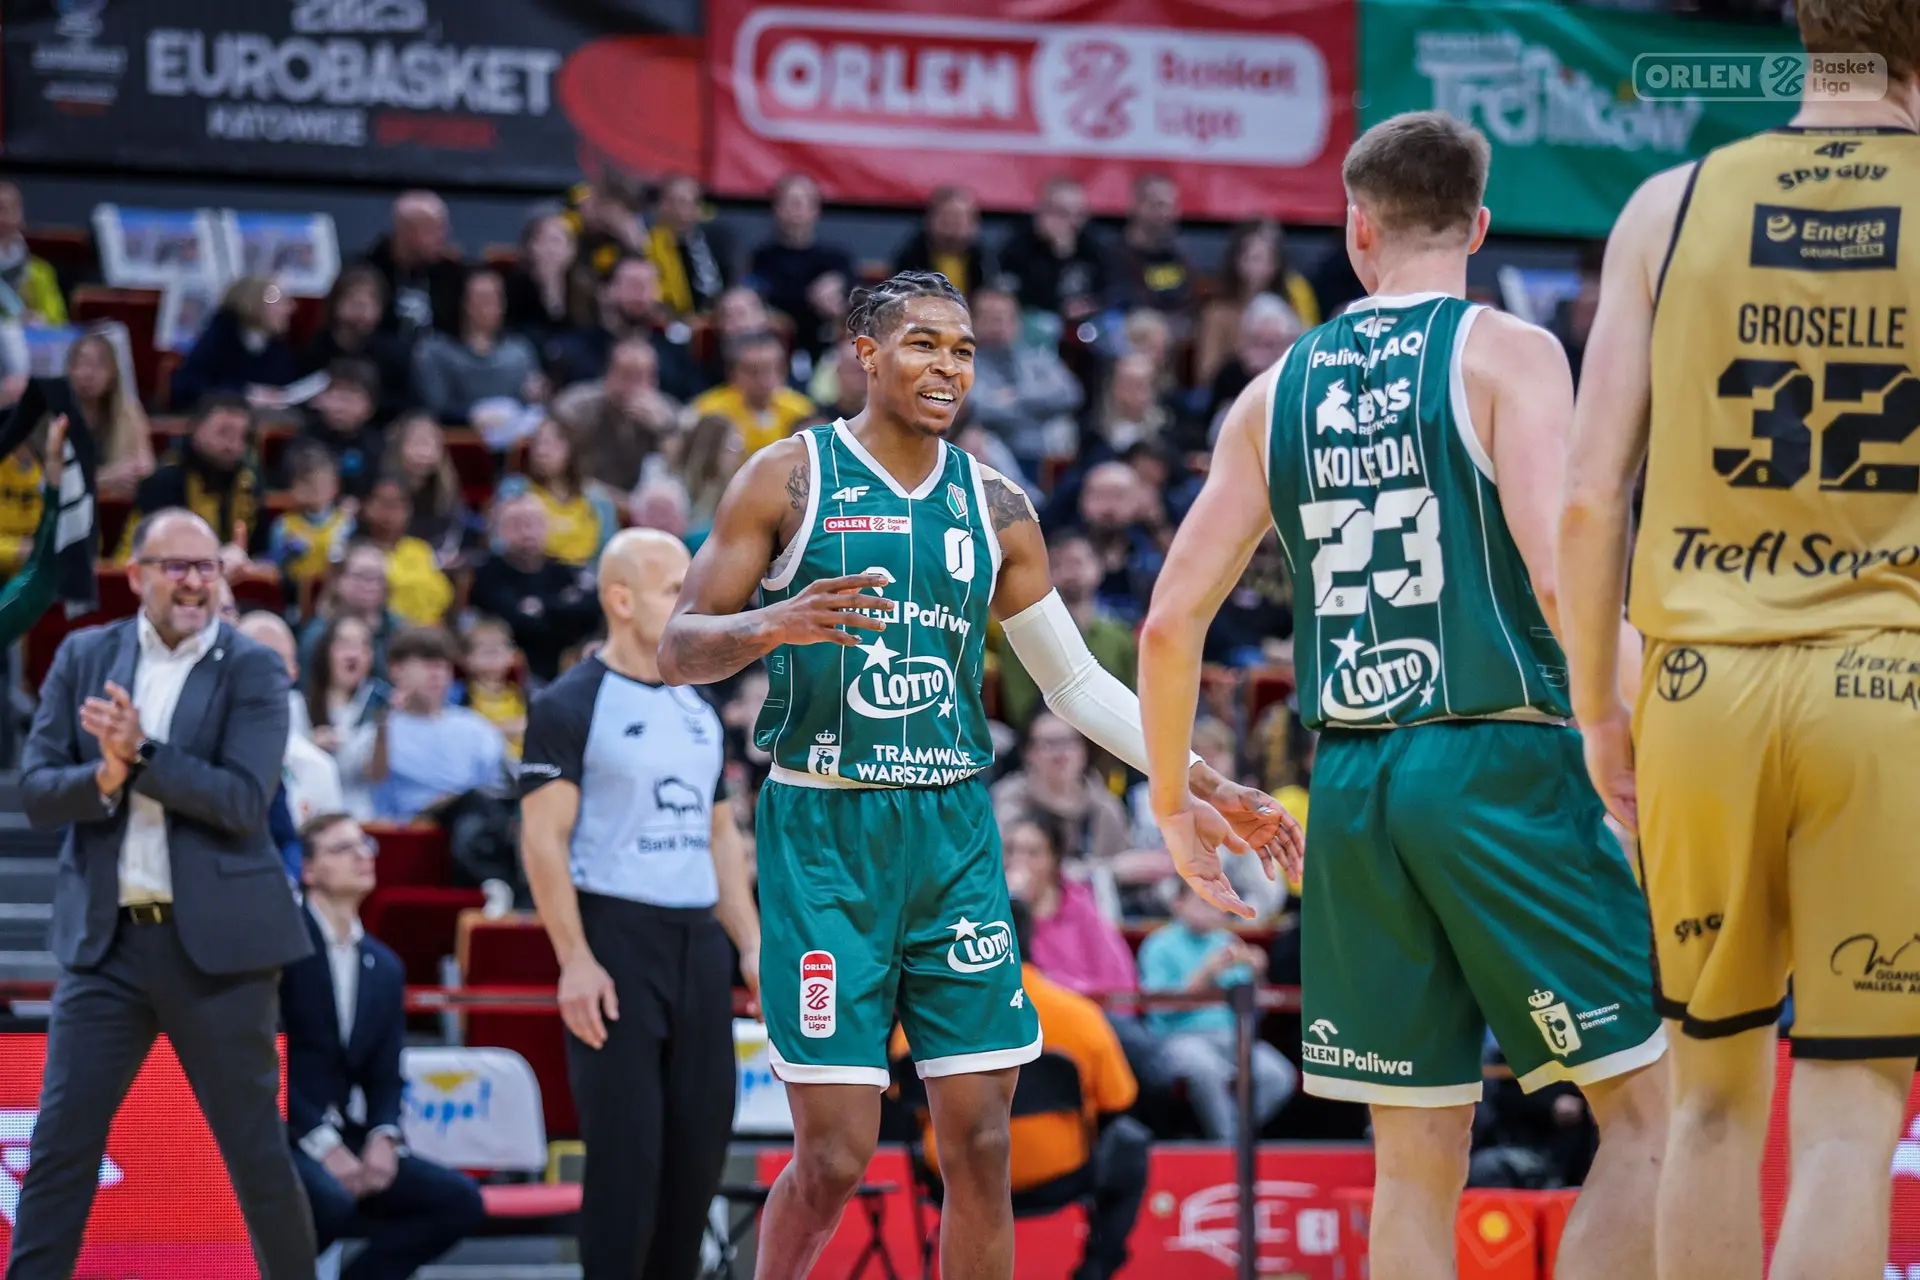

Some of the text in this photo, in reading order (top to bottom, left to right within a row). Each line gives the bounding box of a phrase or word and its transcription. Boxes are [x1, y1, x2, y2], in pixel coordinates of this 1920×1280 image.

[146, 29, 561, 116] EUROBASKET
[769, 38, 1018, 119] ORLEN
[1153, 48, 1297, 94] Basket
[1153, 102, 1243, 141] Liga
[1814, 141, 1863, 158] 4F
[1802, 219, 1886, 244] Energa
[1354, 316, 1397, 338] 4F
[1738, 302, 1907, 349] GROSELLE
[1712, 358, 1920, 493] 32
[831, 485, 870, 502] 4F
[828, 519, 868, 529] ORLEN
[887, 517, 908, 525] Basket
[944, 527, 975, 583] 0
[1299, 486, 1445, 616] 23
[1673, 527, 1787, 583] Trefl
[904, 602, 972, 638] Paliw
[872, 668, 944, 706] LOTTO
[1340, 652, 1423, 705] LOTTO
[873, 744, 977, 766] TRAMWAJE
[964, 929, 1009, 963] LOTTO
[804, 963, 832, 971] ORLEN
[803, 1014, 831, 1022] Basket
[808, 1022, 826, 1031] Liga
[1576, 1003, 1620, 1020] Warszawa
[1343, 1048, 1413, 1075] Paliwa
